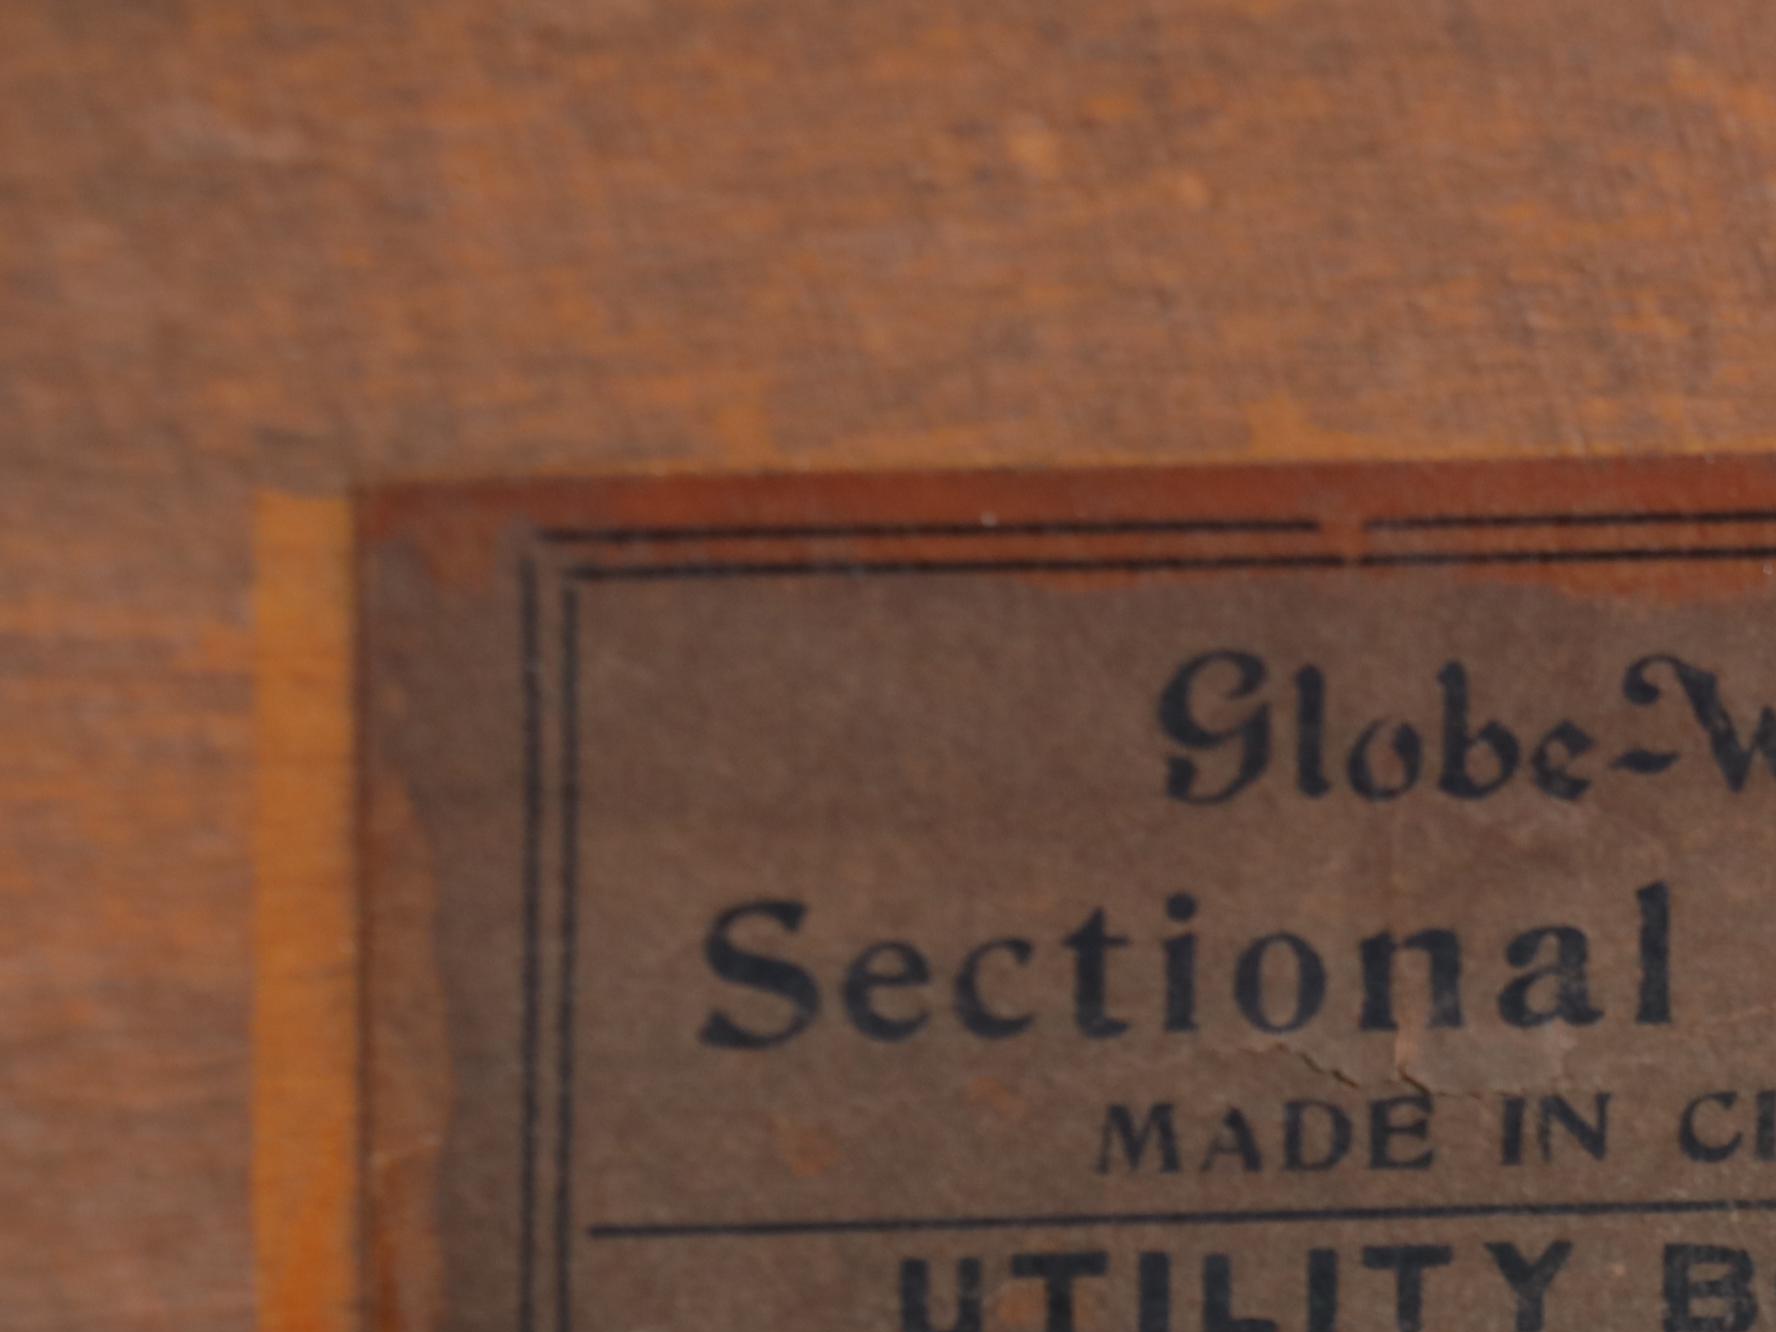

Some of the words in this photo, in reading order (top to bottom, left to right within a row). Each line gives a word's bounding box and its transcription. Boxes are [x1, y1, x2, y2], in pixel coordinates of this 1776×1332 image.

[702, 882, 1674, 1051] Sectional
[1101, 1100, 1436, 1173] MADE
[1502, 1094, 1608, 1162] IN
